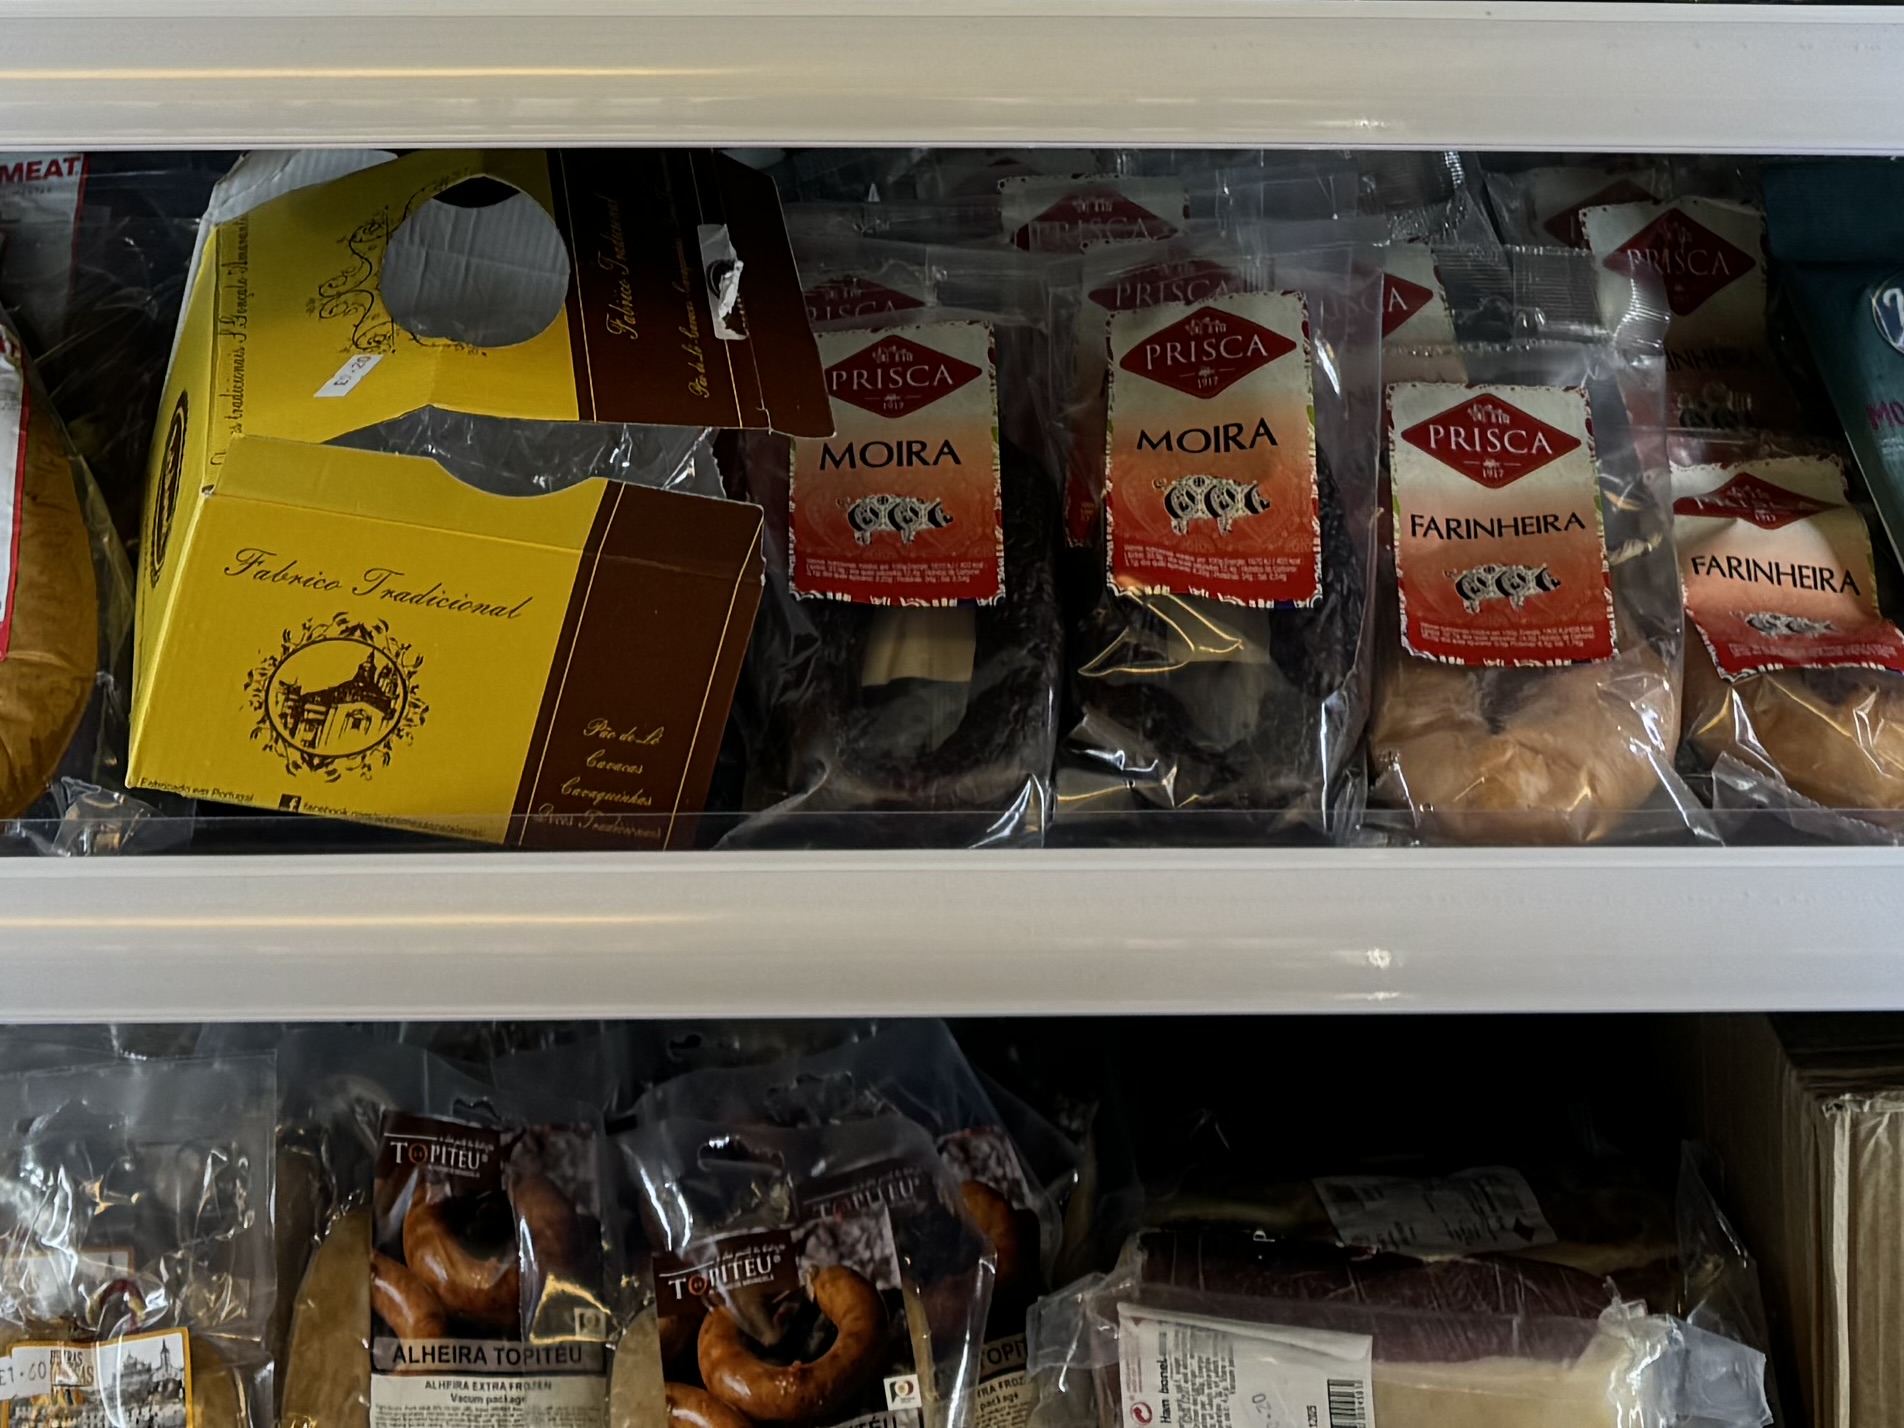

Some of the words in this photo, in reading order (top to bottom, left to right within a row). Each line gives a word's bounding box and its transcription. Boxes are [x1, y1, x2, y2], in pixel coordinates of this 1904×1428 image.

[1626, 247, 1730, 279] PRISCA
[605, 279, 639, 341] Fabrico
[1144, 334, 1270, 370] PRISCA
[830, 364, 955, 391] PRISCA
[1136, 417, 1279, 454] MOIRA
[1428, 423, 1553, 456] PRISCA
[818, 439, 963, 471] MOIRA
[1409, 511, 1586, 541] FARINHEIRA
[223, 546, 344, 596] Fabrico
[350, 566, 534, 623] Tradicional
[1691, 555, 1861, 597] FARINHEIRA
[583, 717, 616, 740] Pão
[585, 748, 644, 775] Cavacas
[560, 776, 653, 807] Cavaquinhas
[392, 1345, 488, 1365] ALHEIRA
[425, 1380, 469, 1392] ALHEIRA
[472, 1381, 507, 1392] EXTRA
[450, 1393, 484, 1404] Vacum
[1159, 1399, 1172, 1424] Ham
